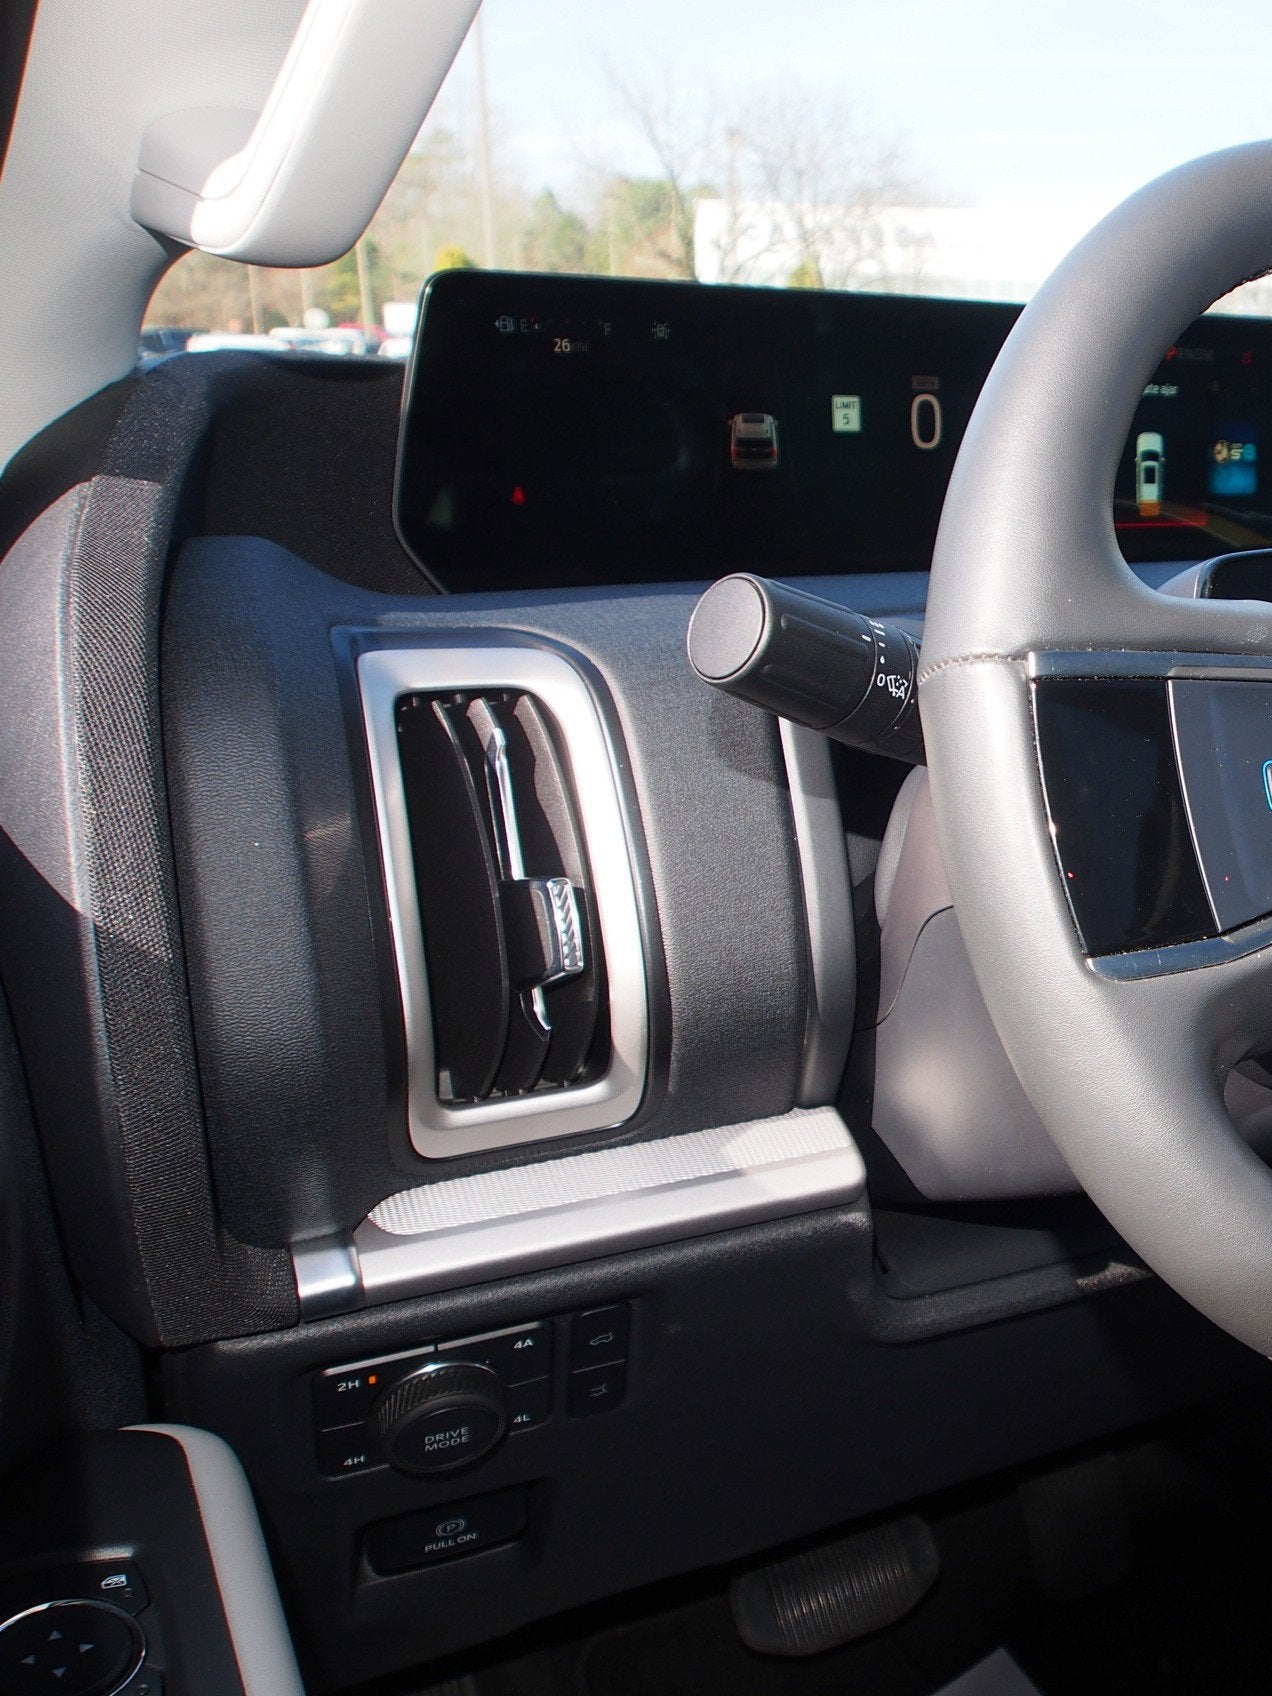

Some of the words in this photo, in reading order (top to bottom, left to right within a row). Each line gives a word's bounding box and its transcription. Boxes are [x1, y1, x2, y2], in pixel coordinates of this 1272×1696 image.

[553, 338, 571, 352] 26
[835, 401, 857, 409] LIMIT
[842, 413, 850, 425] 5
[911, 393, 941, 449] 0
[513, 1337, 534, 1350] 4A
[337, 1379, 360, 1392] 2H
[513, 1414, 531, 1425] 4L
[424, 1426, 470, 1445] DRIVE
[424, 1434, 470, 1453] MODE
[343, 1455, 366, 1466] 4H
[424, 1539, 456, 1553] PULL
[456, 1532, 477, 1544] ON
